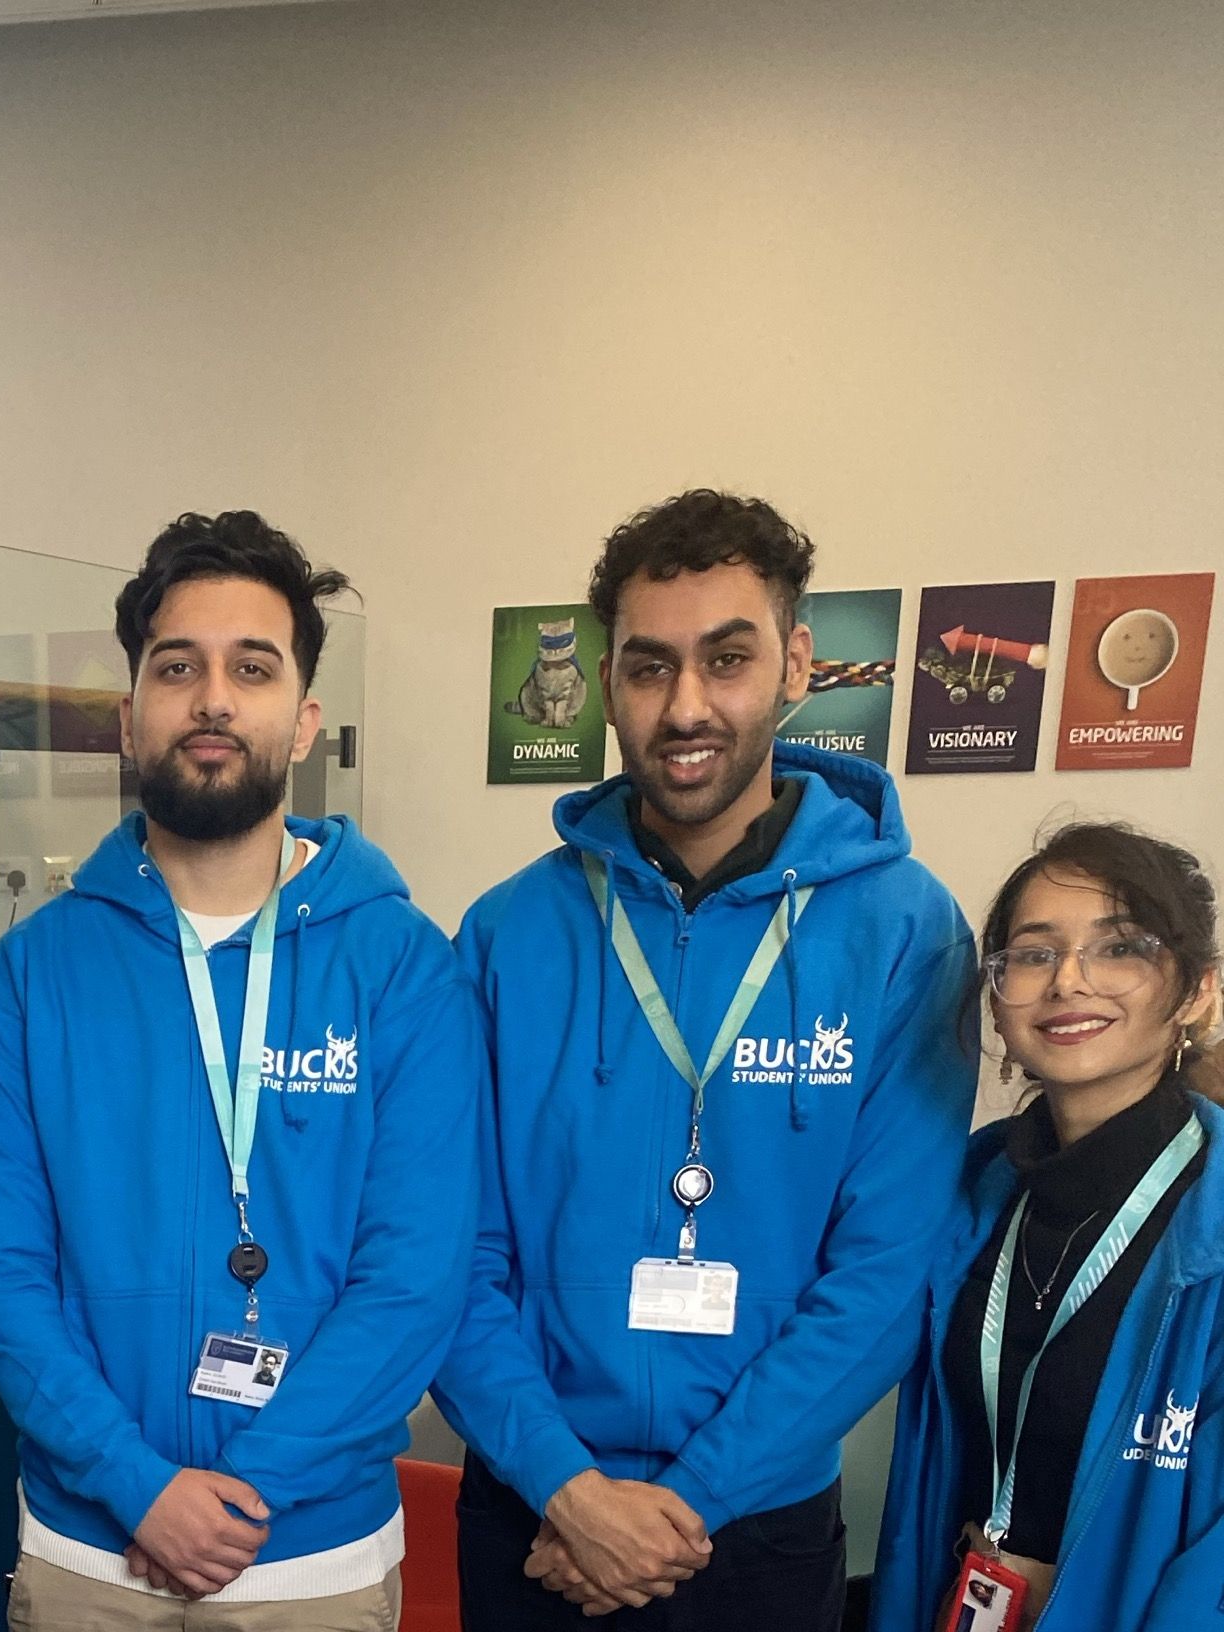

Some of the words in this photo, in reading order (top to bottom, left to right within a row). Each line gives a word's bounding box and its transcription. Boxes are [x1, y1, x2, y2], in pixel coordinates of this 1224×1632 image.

[927, 730, 1018, 748] VISIONARY
[1069, 725, 1185, 744] EMPOWERING
[513, 743, 580, 760] DYNAMIC
[733, 1034, 854, 1071] BUCKS
[260, 1043, 358, 1080] BUCKS
[808, 1072, 853, 1085] UNION
[323, 1081, 357, 1094] UNION
[1155, 1454, 1188, 1470] UNIO
